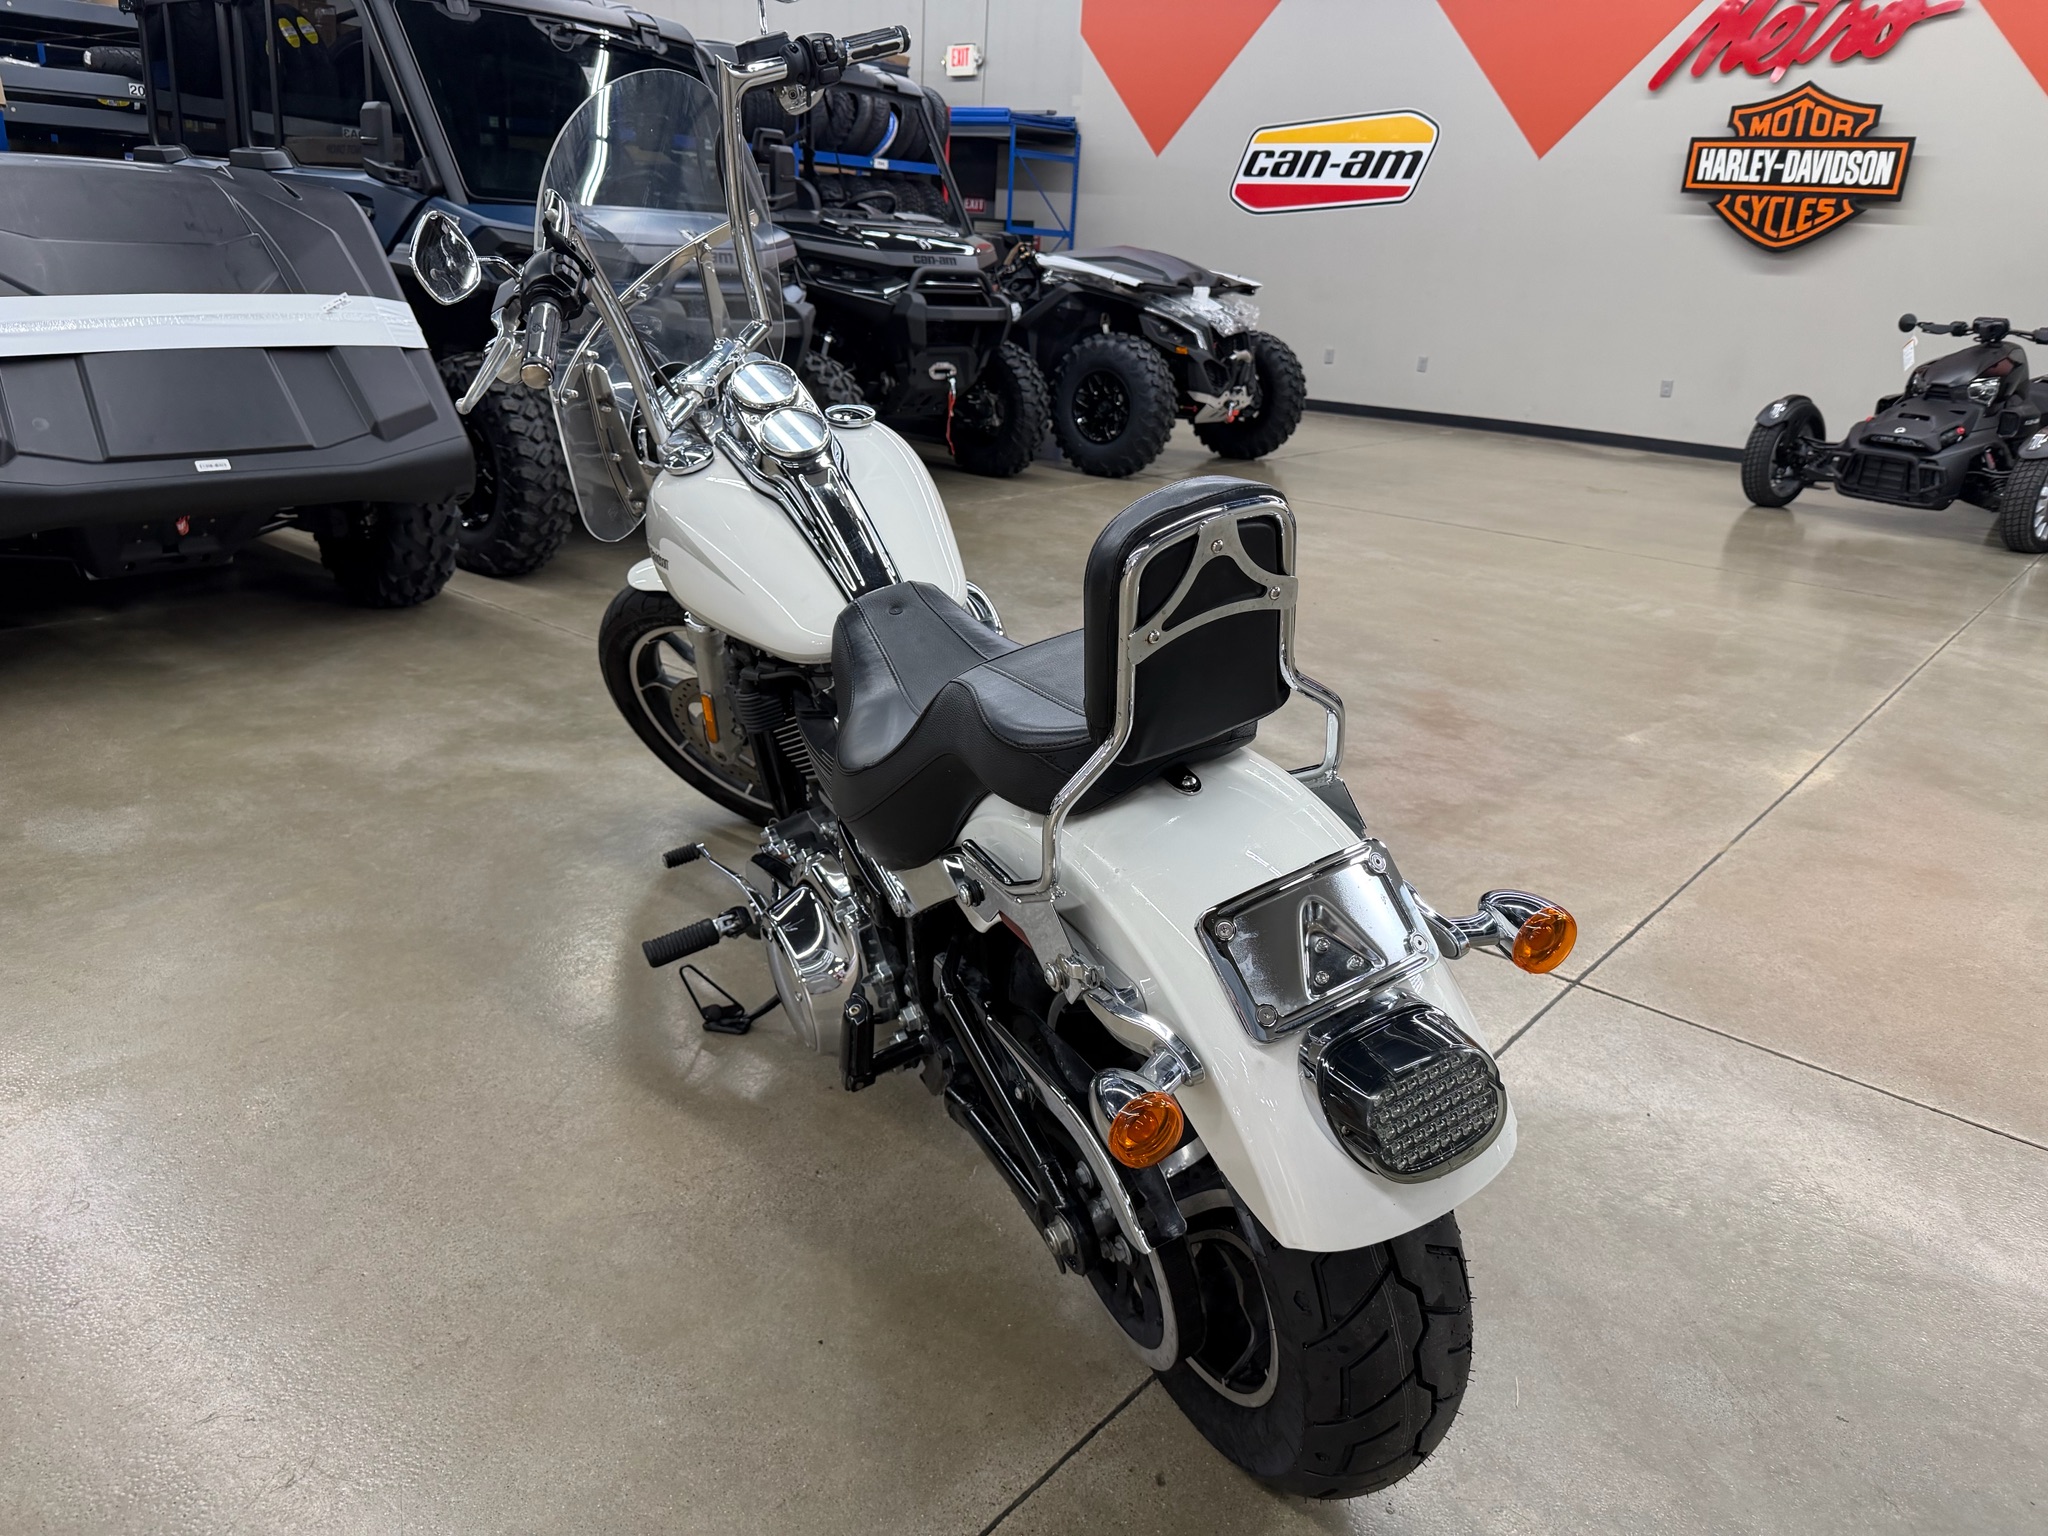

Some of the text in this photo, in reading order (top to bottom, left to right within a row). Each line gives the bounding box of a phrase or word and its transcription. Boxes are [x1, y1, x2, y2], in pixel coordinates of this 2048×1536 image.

[951, 47, 970, 67] EXIT
[1648, 0, 1965, 91] Metro
[130, 84, 146, 96] 20
[1749, 98, 1854, 137] MOTOR
[1242, 150, 1424, 179] can-am
[1696, 148, 1896, 186] HARLEY-DAVIDSON
[1733, 194, 1836, 238] CYCLES
[913, 254, 957, 266] can-am
